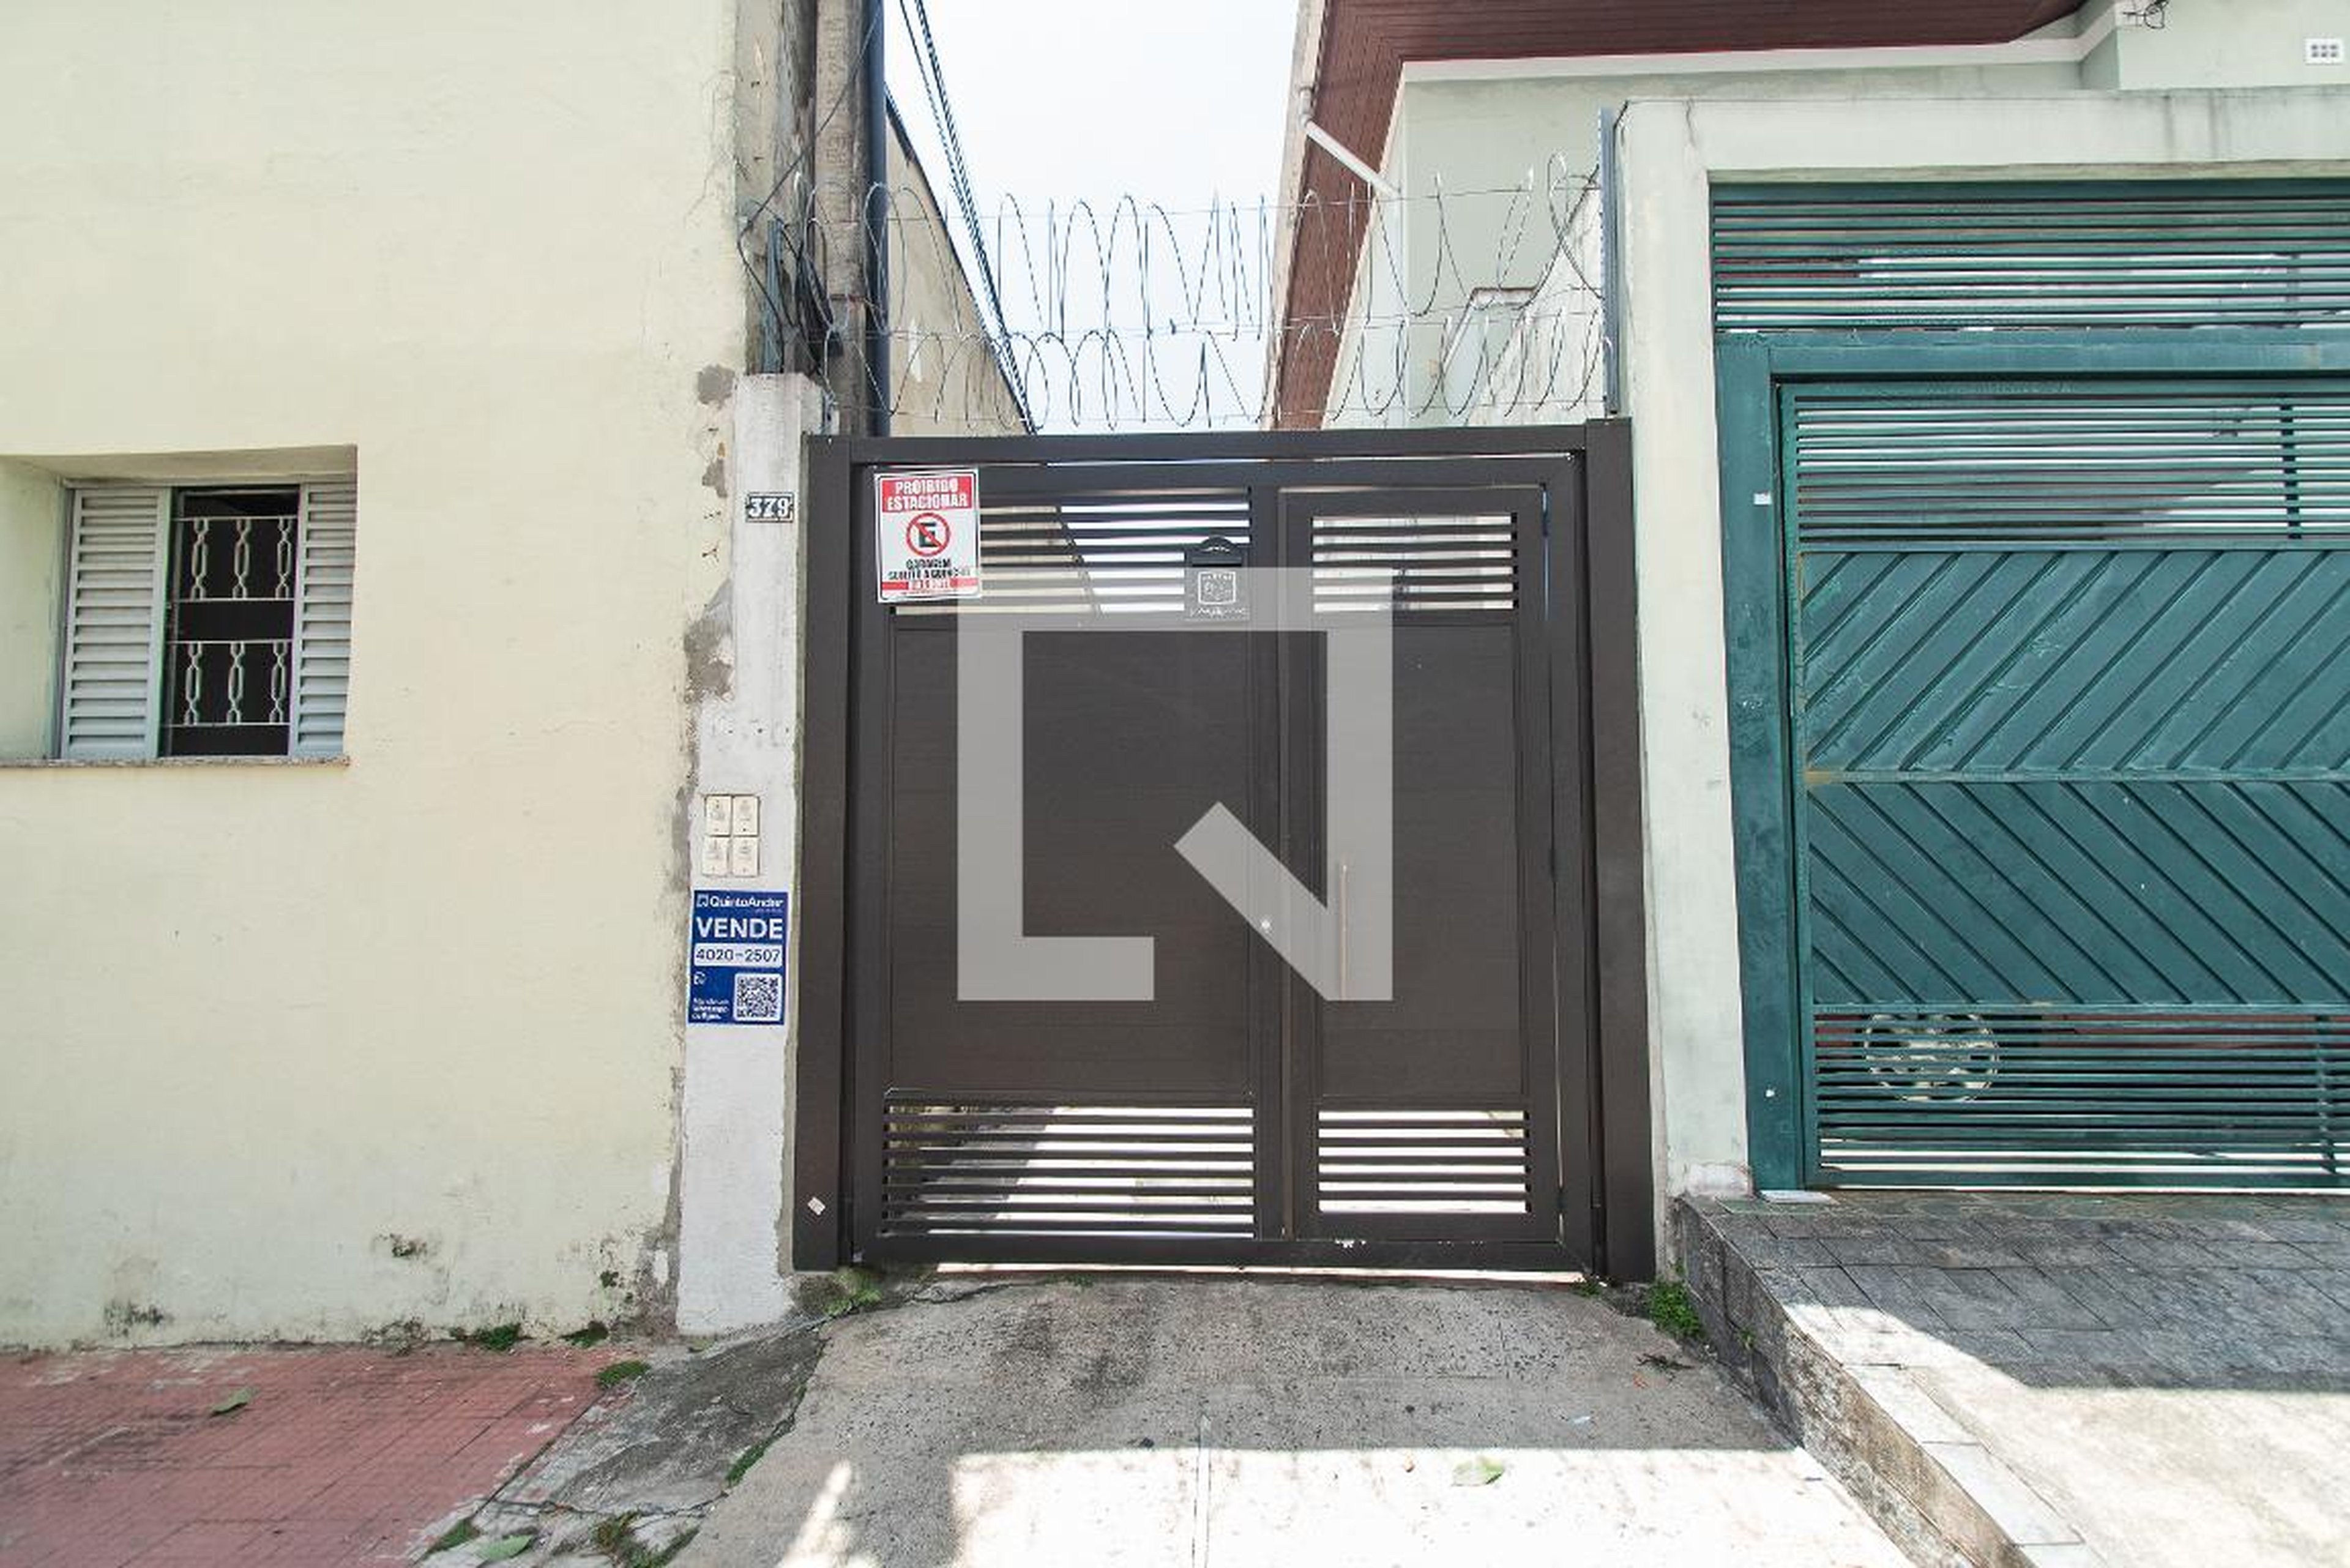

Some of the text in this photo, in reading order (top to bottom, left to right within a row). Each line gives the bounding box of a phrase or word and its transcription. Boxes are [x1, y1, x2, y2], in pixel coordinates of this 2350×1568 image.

[895, 478, 958, 495] PROIBIDO
[748, 498, 789, 517] 379
[887, 493, 968, 511] ESTACIONAR
[696, 917, 783, 939] VENDE
[696, 949, 780, 962] 4020-2507
